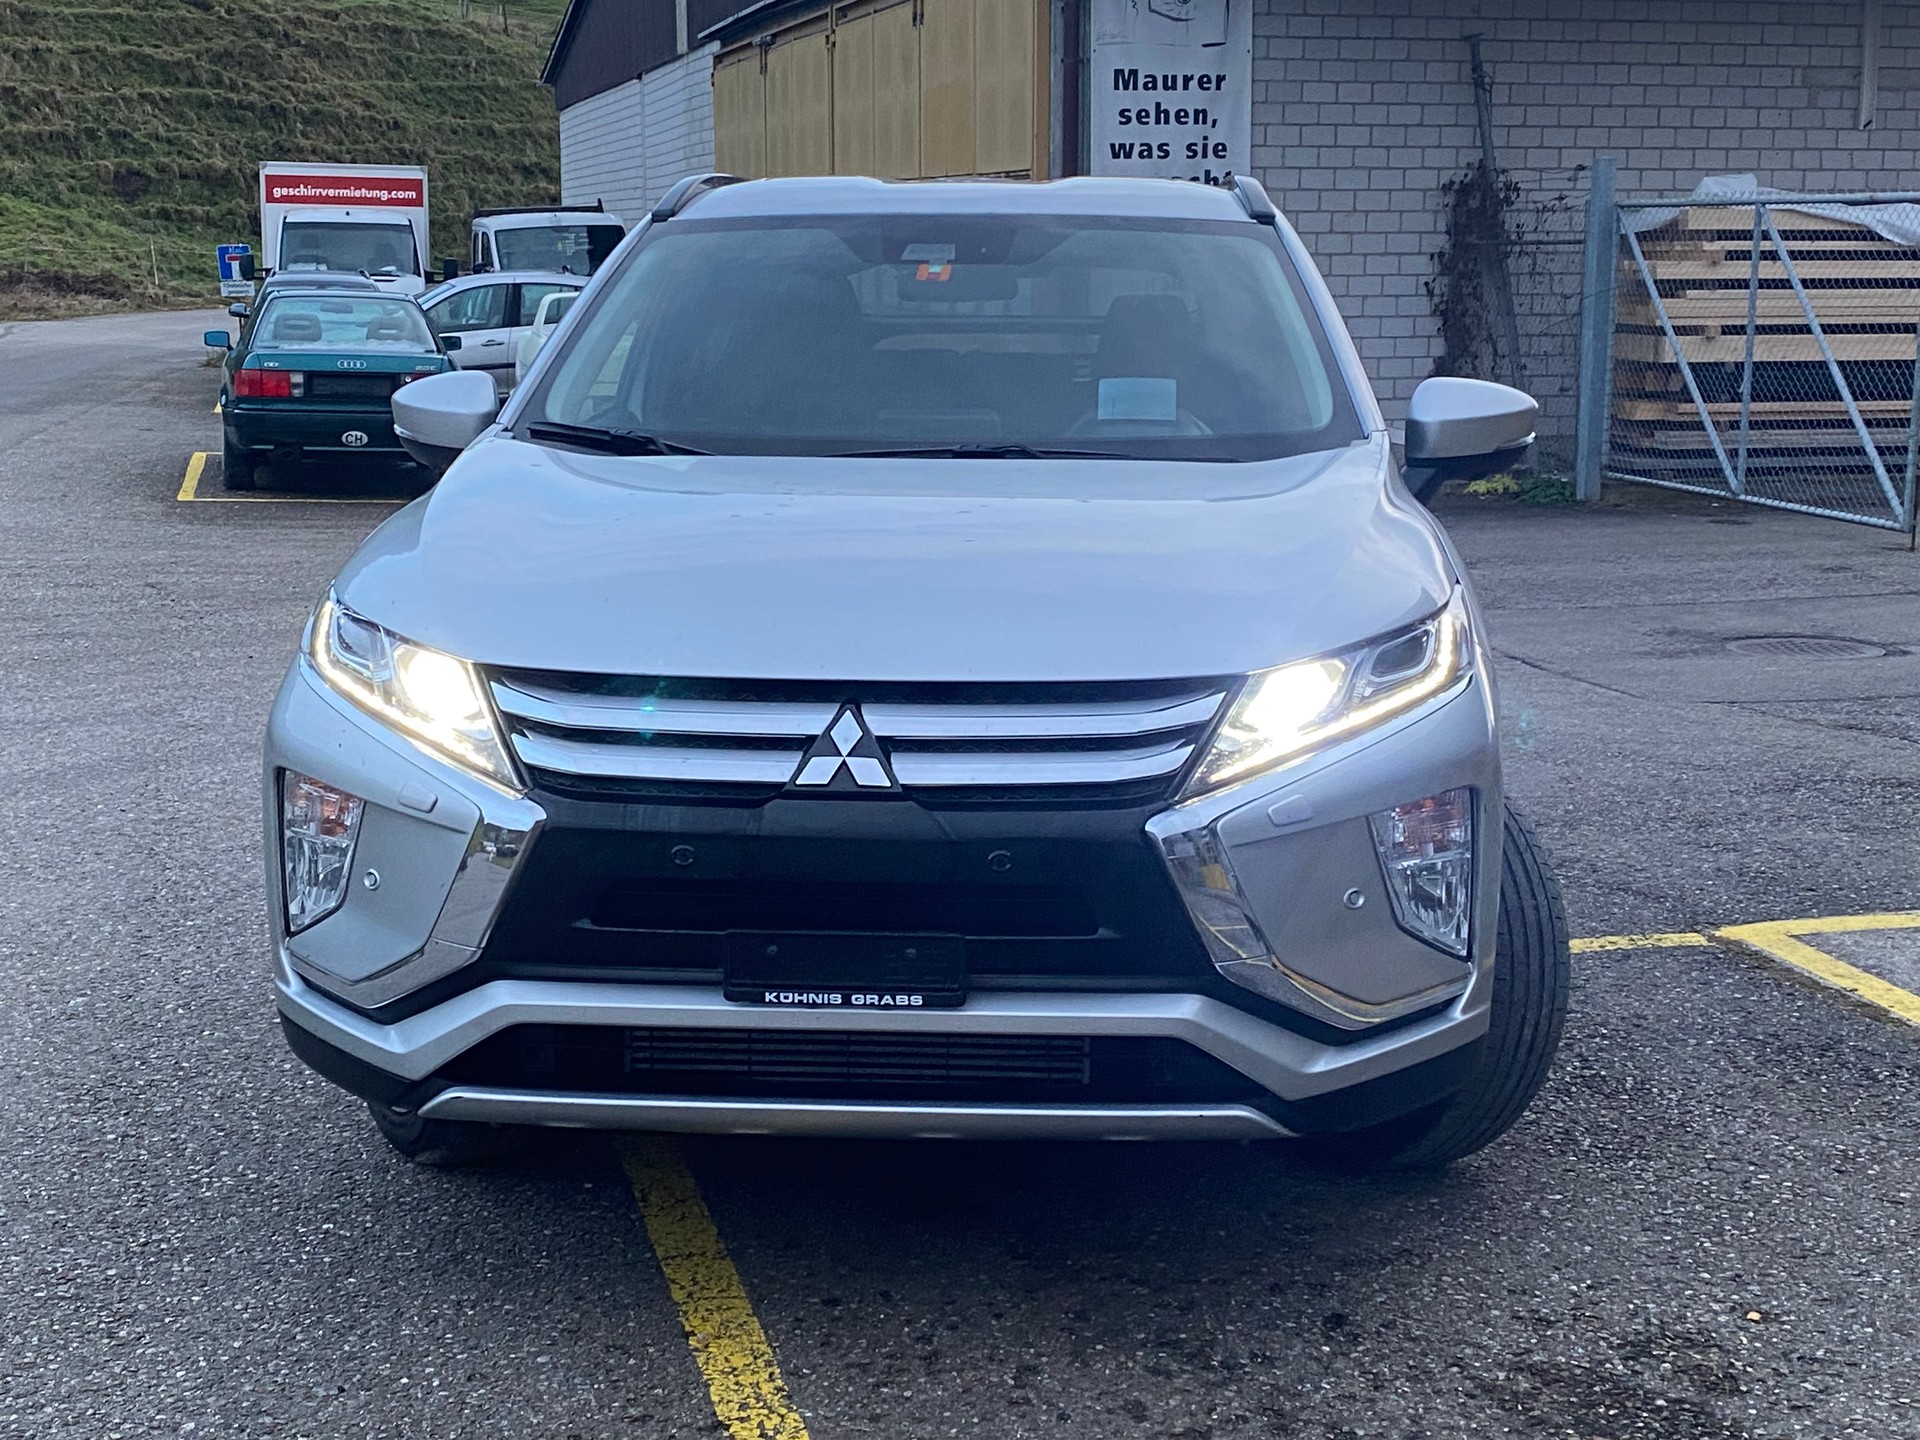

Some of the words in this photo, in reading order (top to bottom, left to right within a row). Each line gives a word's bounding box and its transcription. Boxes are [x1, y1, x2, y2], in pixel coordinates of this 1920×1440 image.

[1113, 68, 1227, 92] Maurer
[1118, 101, 1218, 129] sehen,
[1109, 141, 1171, 160] was
[1185, 135, 1228, 160] sie
[272, 184, 417, 201] geschirrvermietung.com
[345, 433, 363, 445] CH
[764, 991, 843, 1005] KÜHNIS
[851, 994, 923, 1006] GRABS
